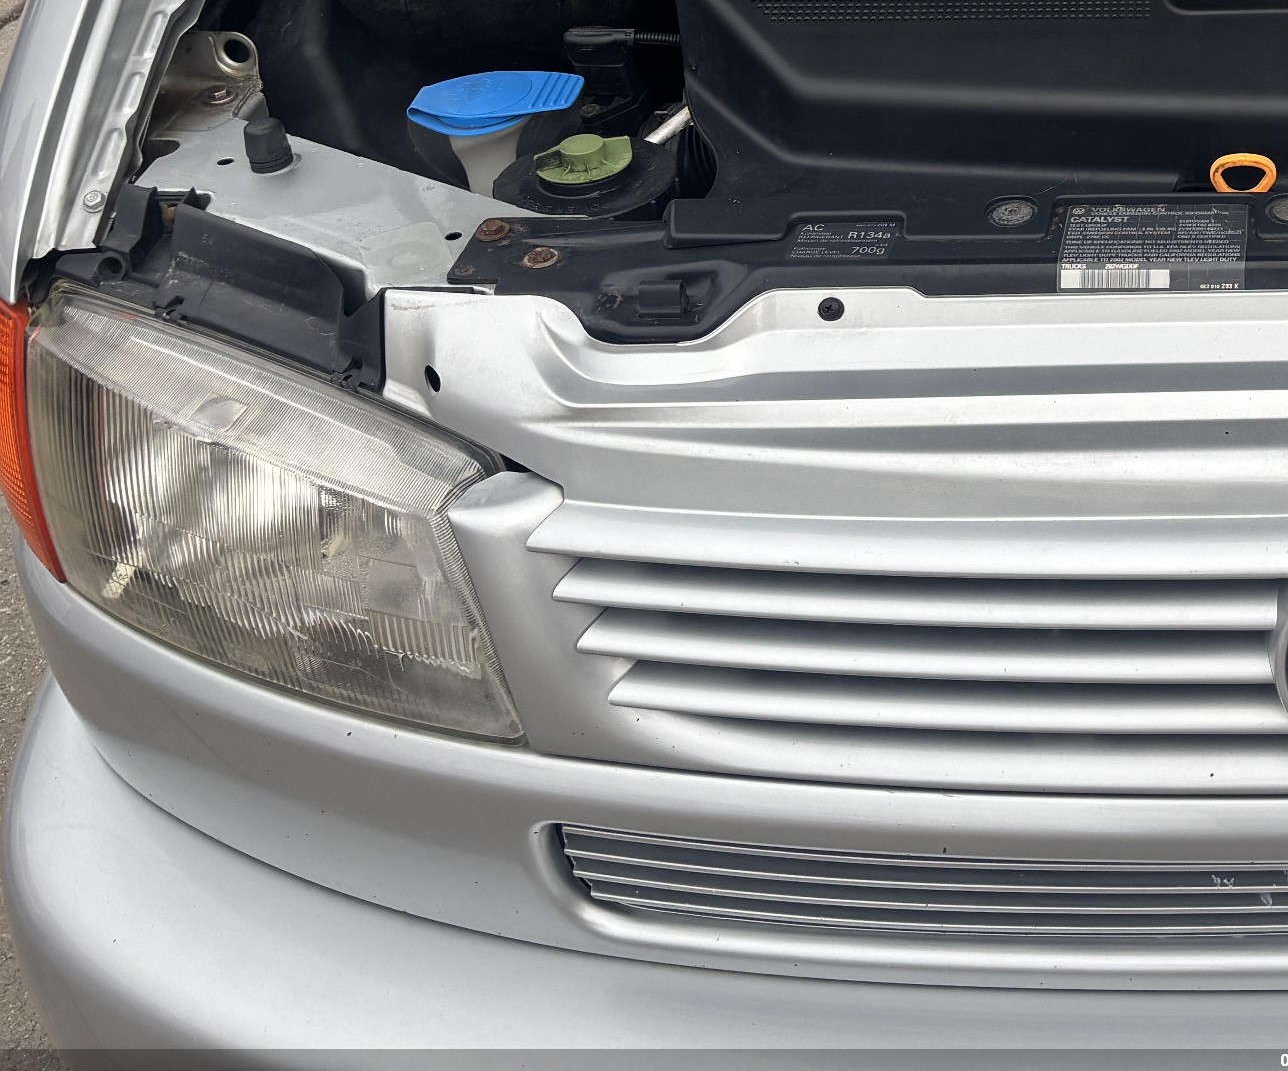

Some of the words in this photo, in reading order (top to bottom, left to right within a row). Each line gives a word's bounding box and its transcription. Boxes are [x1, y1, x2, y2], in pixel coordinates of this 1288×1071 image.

[802, 223, 825, 231] AC
[847, 231, 891, 239] R134a
[851, 246, 886, 255] 700g
